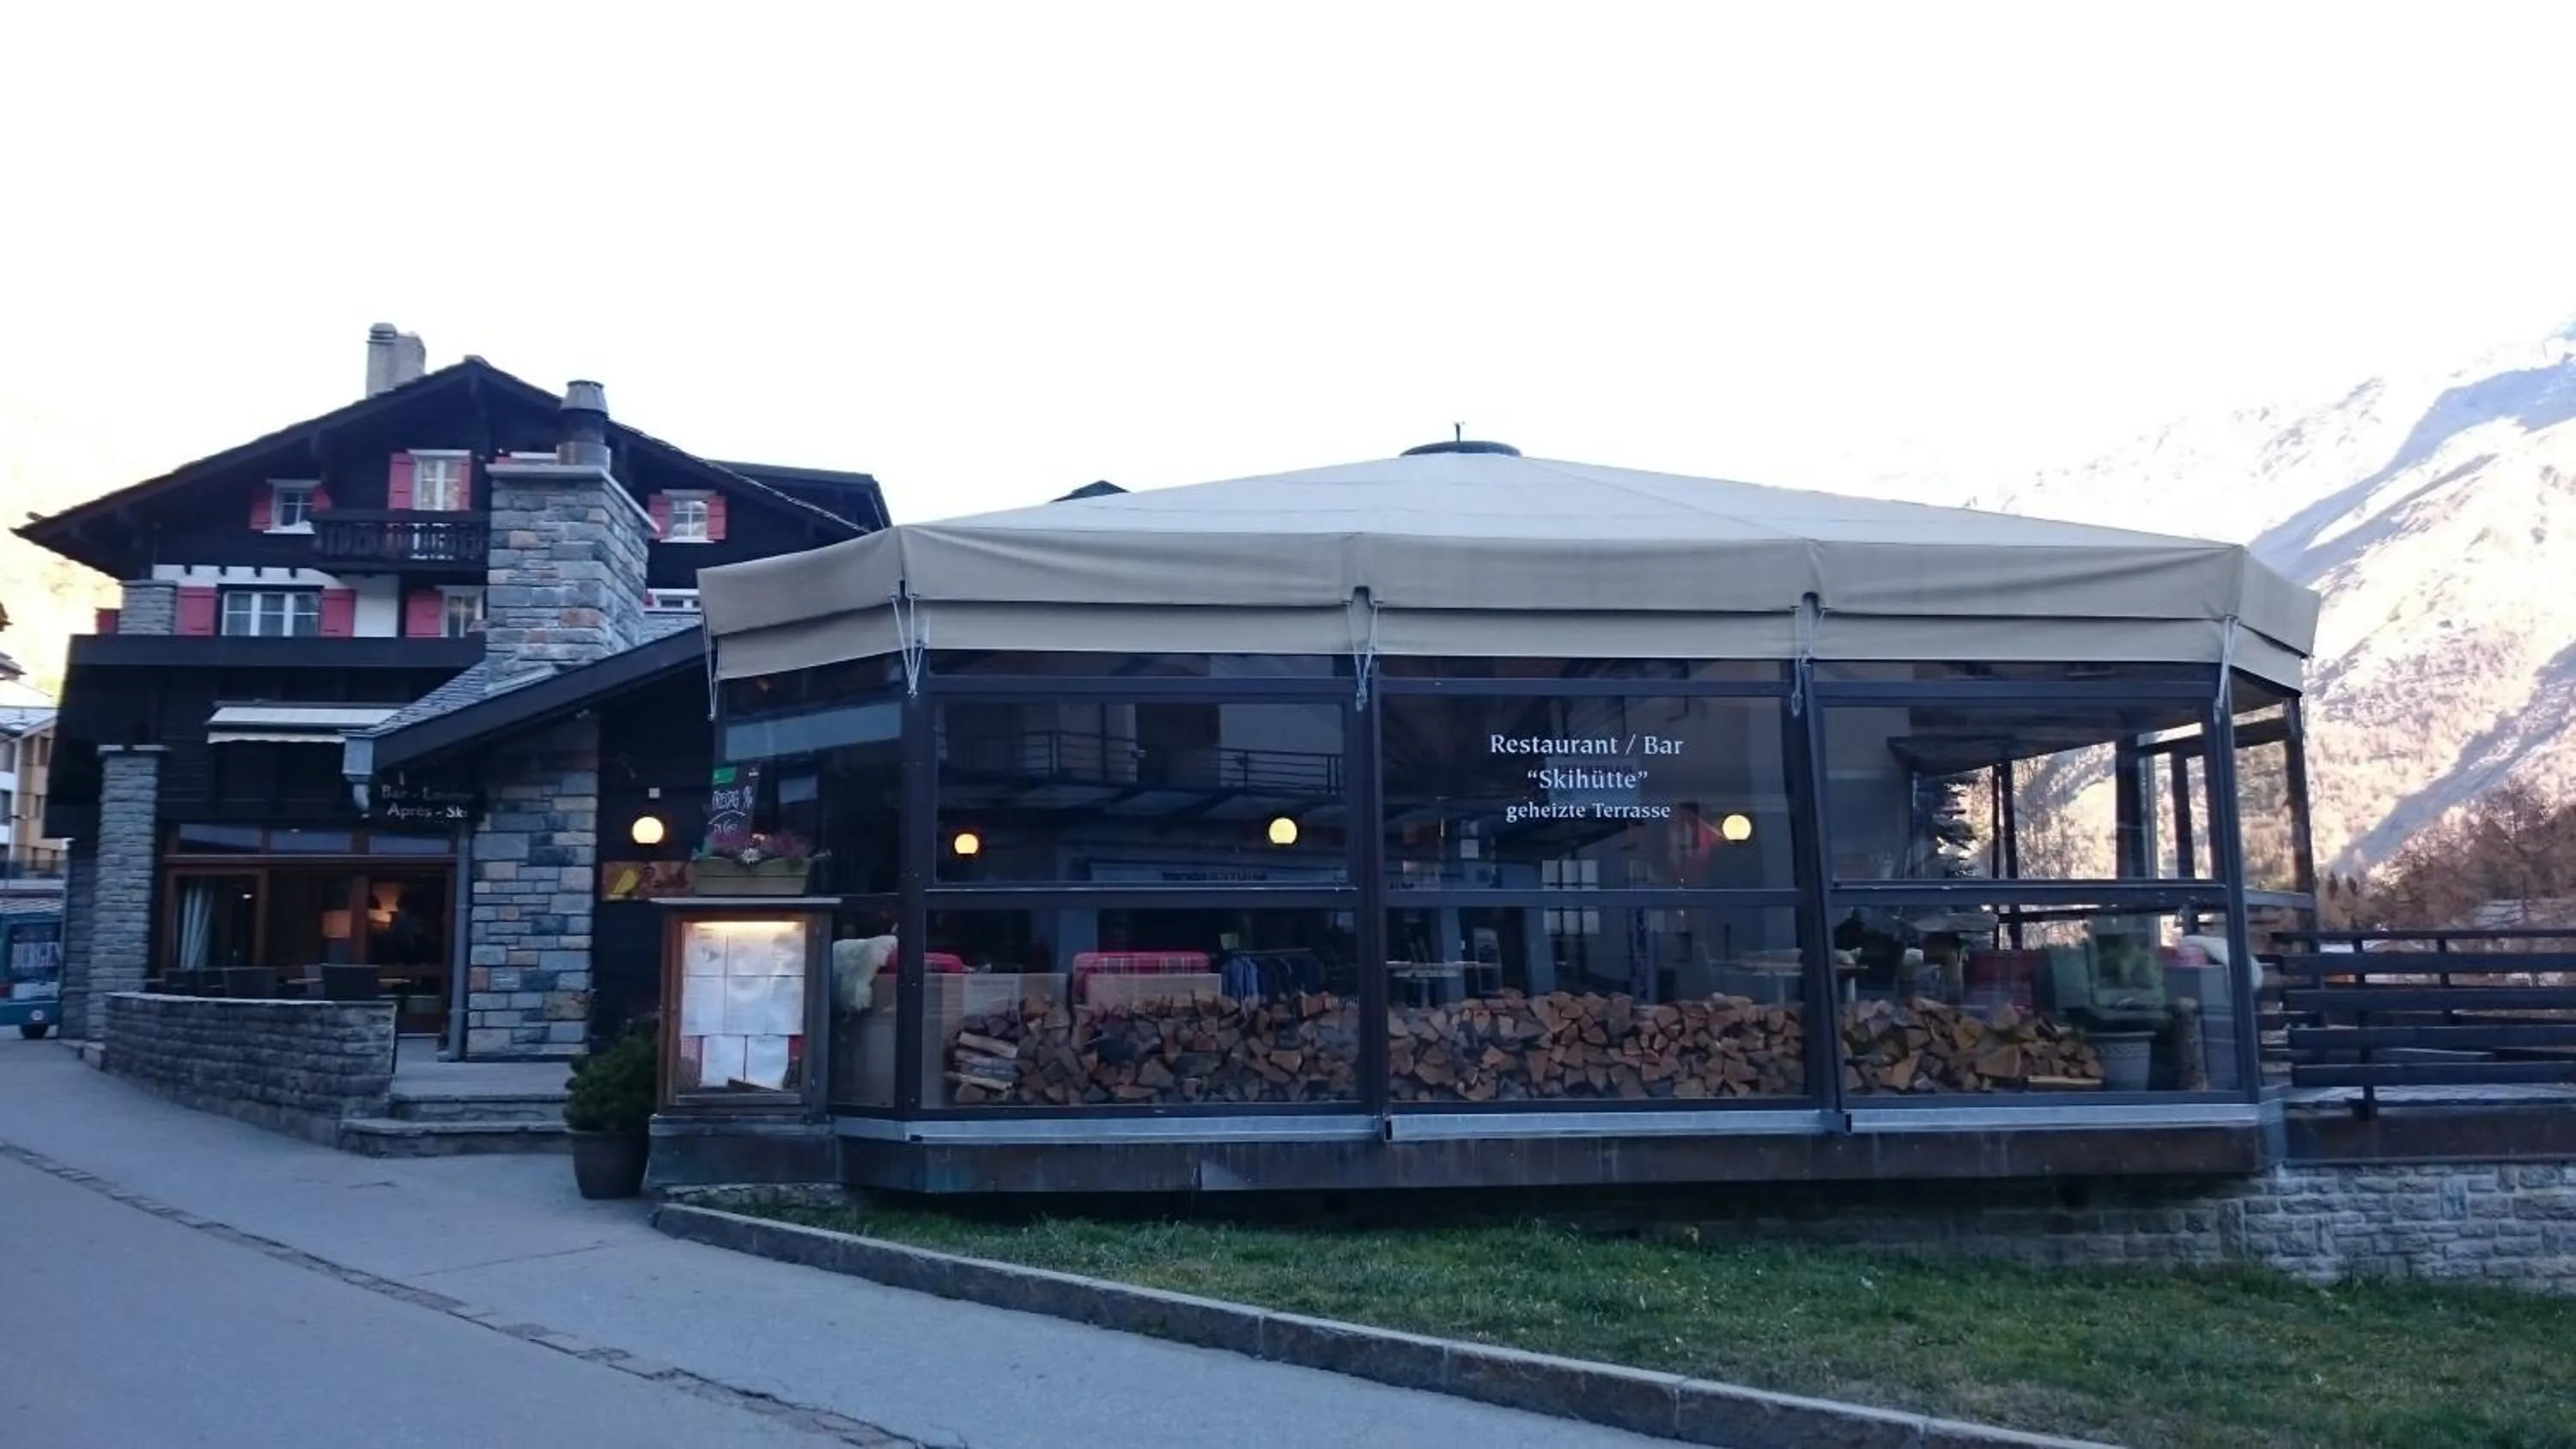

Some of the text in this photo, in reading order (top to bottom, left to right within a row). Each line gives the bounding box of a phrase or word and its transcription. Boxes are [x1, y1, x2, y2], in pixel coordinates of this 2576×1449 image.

[1490, 734, 1685, 755] Restaurant / Bar
[1505, 802, 1671, 823] geheizte Terrasse
